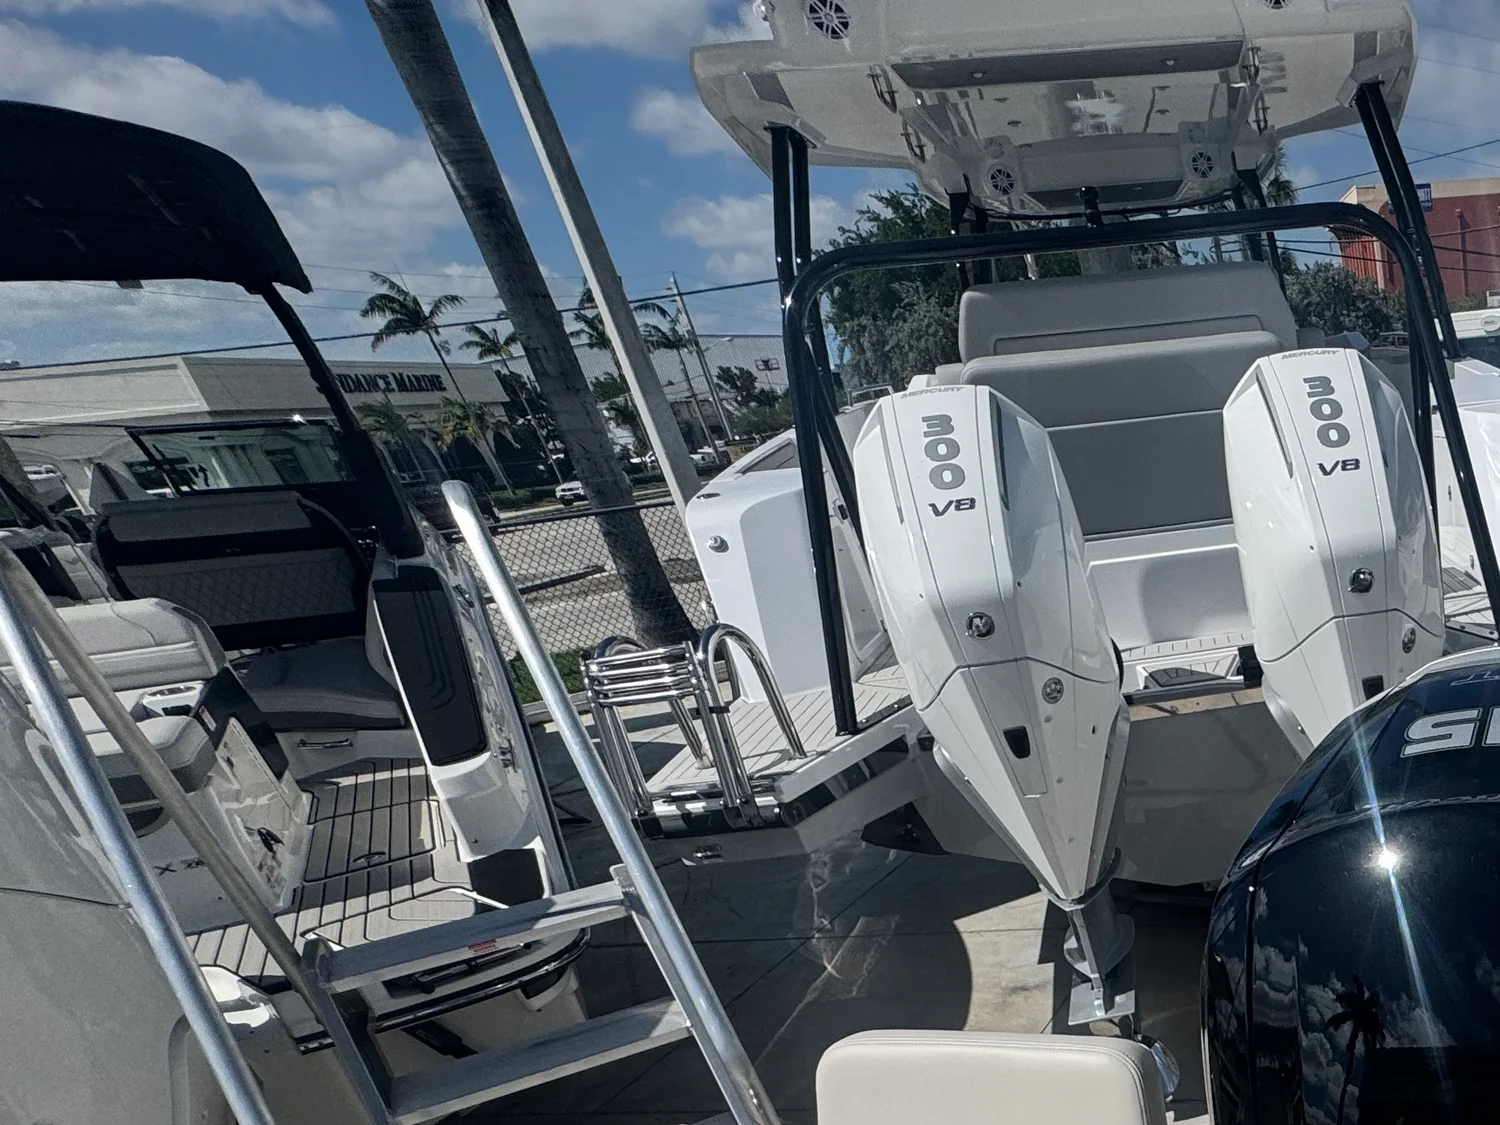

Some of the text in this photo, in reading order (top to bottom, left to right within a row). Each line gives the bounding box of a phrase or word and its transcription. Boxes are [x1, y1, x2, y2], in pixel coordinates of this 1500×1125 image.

[1281, 349, 1340, 360] MERCURY
[388, 372, 447, 392] MARINE
[900, 386, 965, 399] MERCURY
[1303, 375, 1350, 448] 300
[921, 413, 966, 490] 300
[1316, 458, 1361, 476] V8
[928, 497, 977, 517] V8
